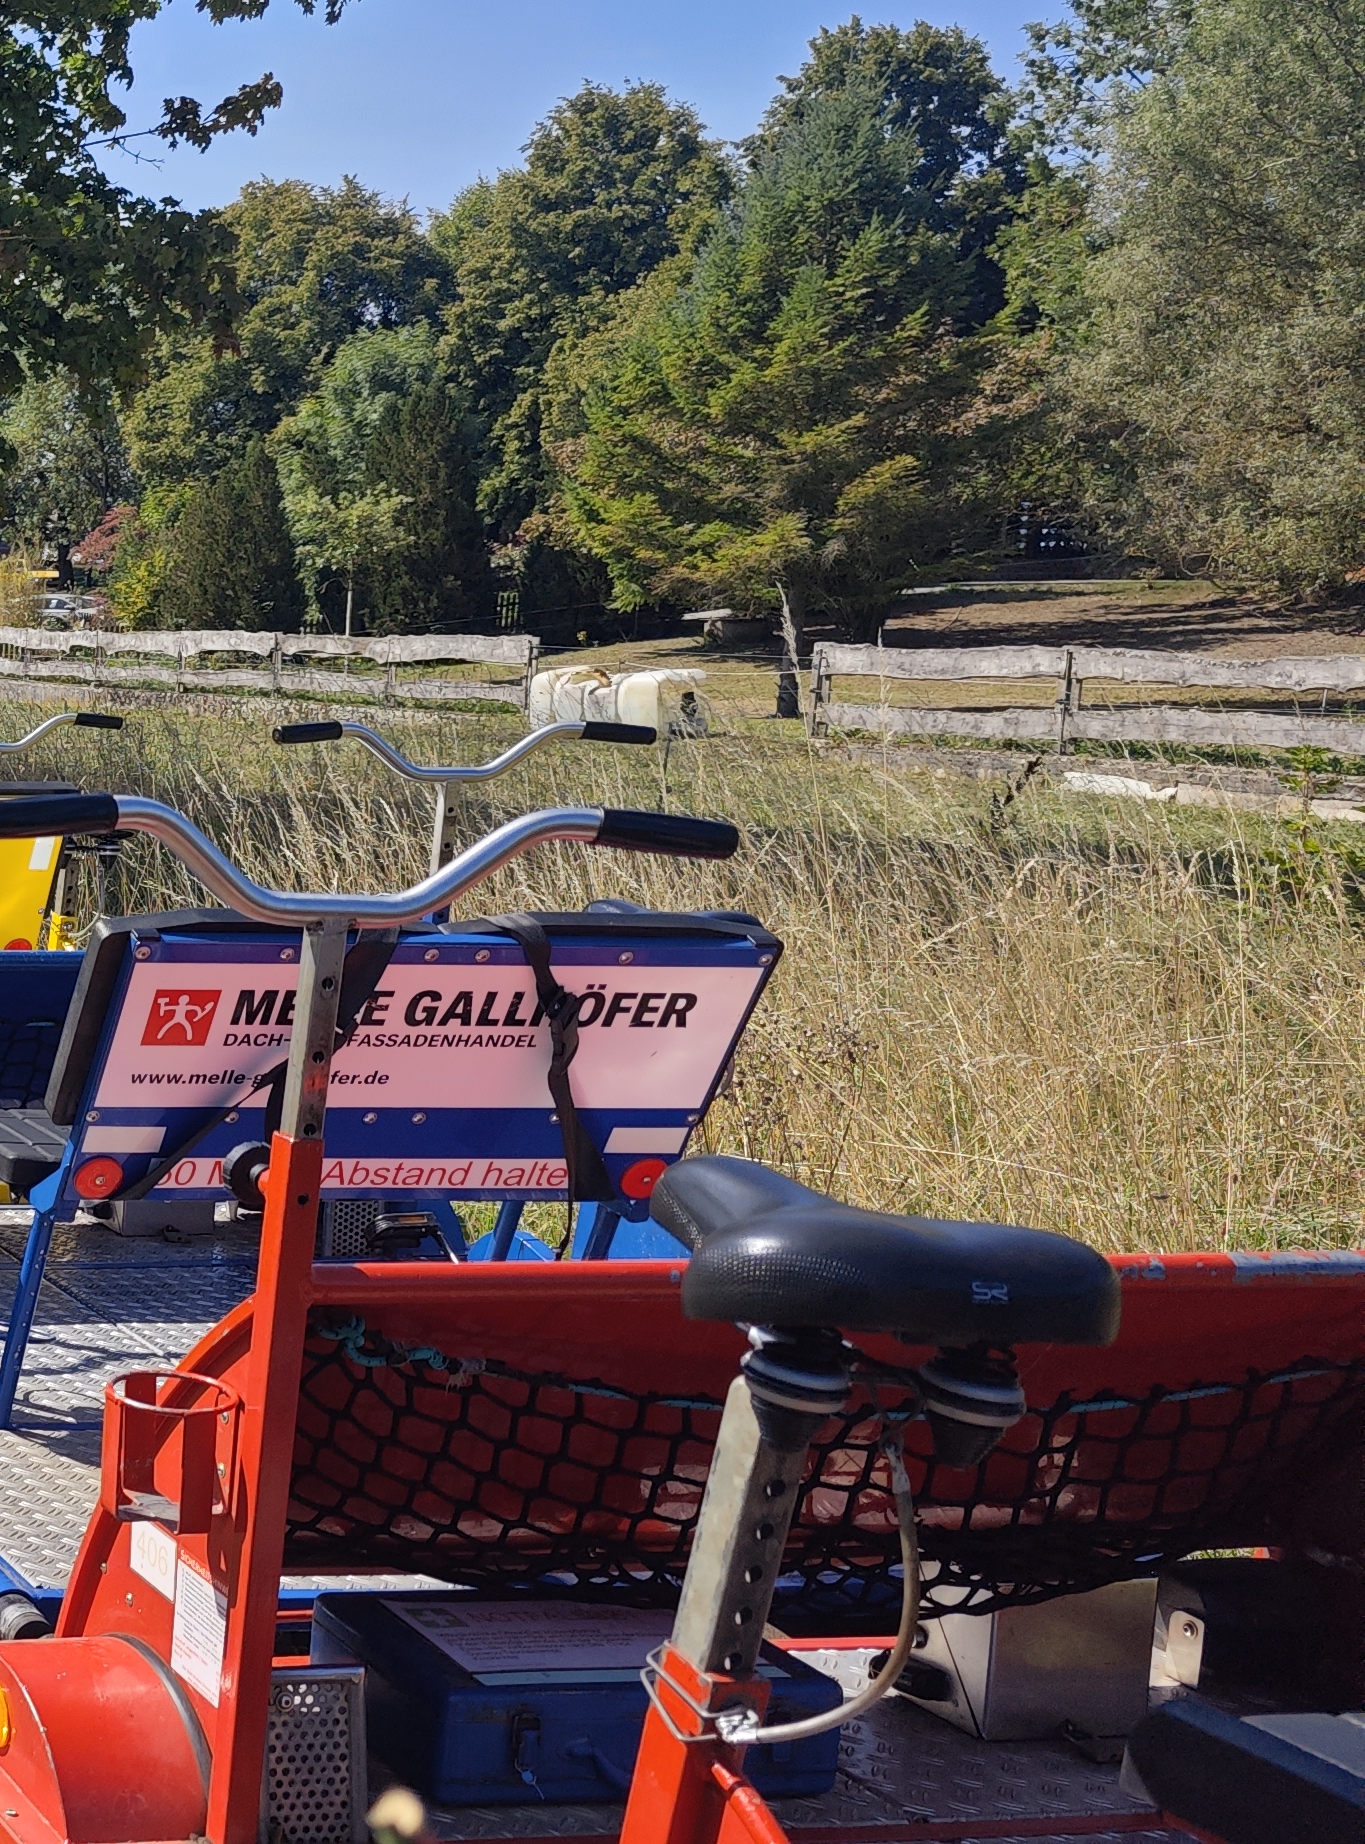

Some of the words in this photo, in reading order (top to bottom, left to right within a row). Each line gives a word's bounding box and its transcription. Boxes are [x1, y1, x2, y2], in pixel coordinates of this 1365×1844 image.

[230, 989, 395, 1026] MEE
[346, 1033, 537, 1048] FASSADENHANDEL
[320, 1160, 473, 1187] Abstand
[480, 1160, 568, 1187] halte
[136, 1529, 169, 1577] 406
